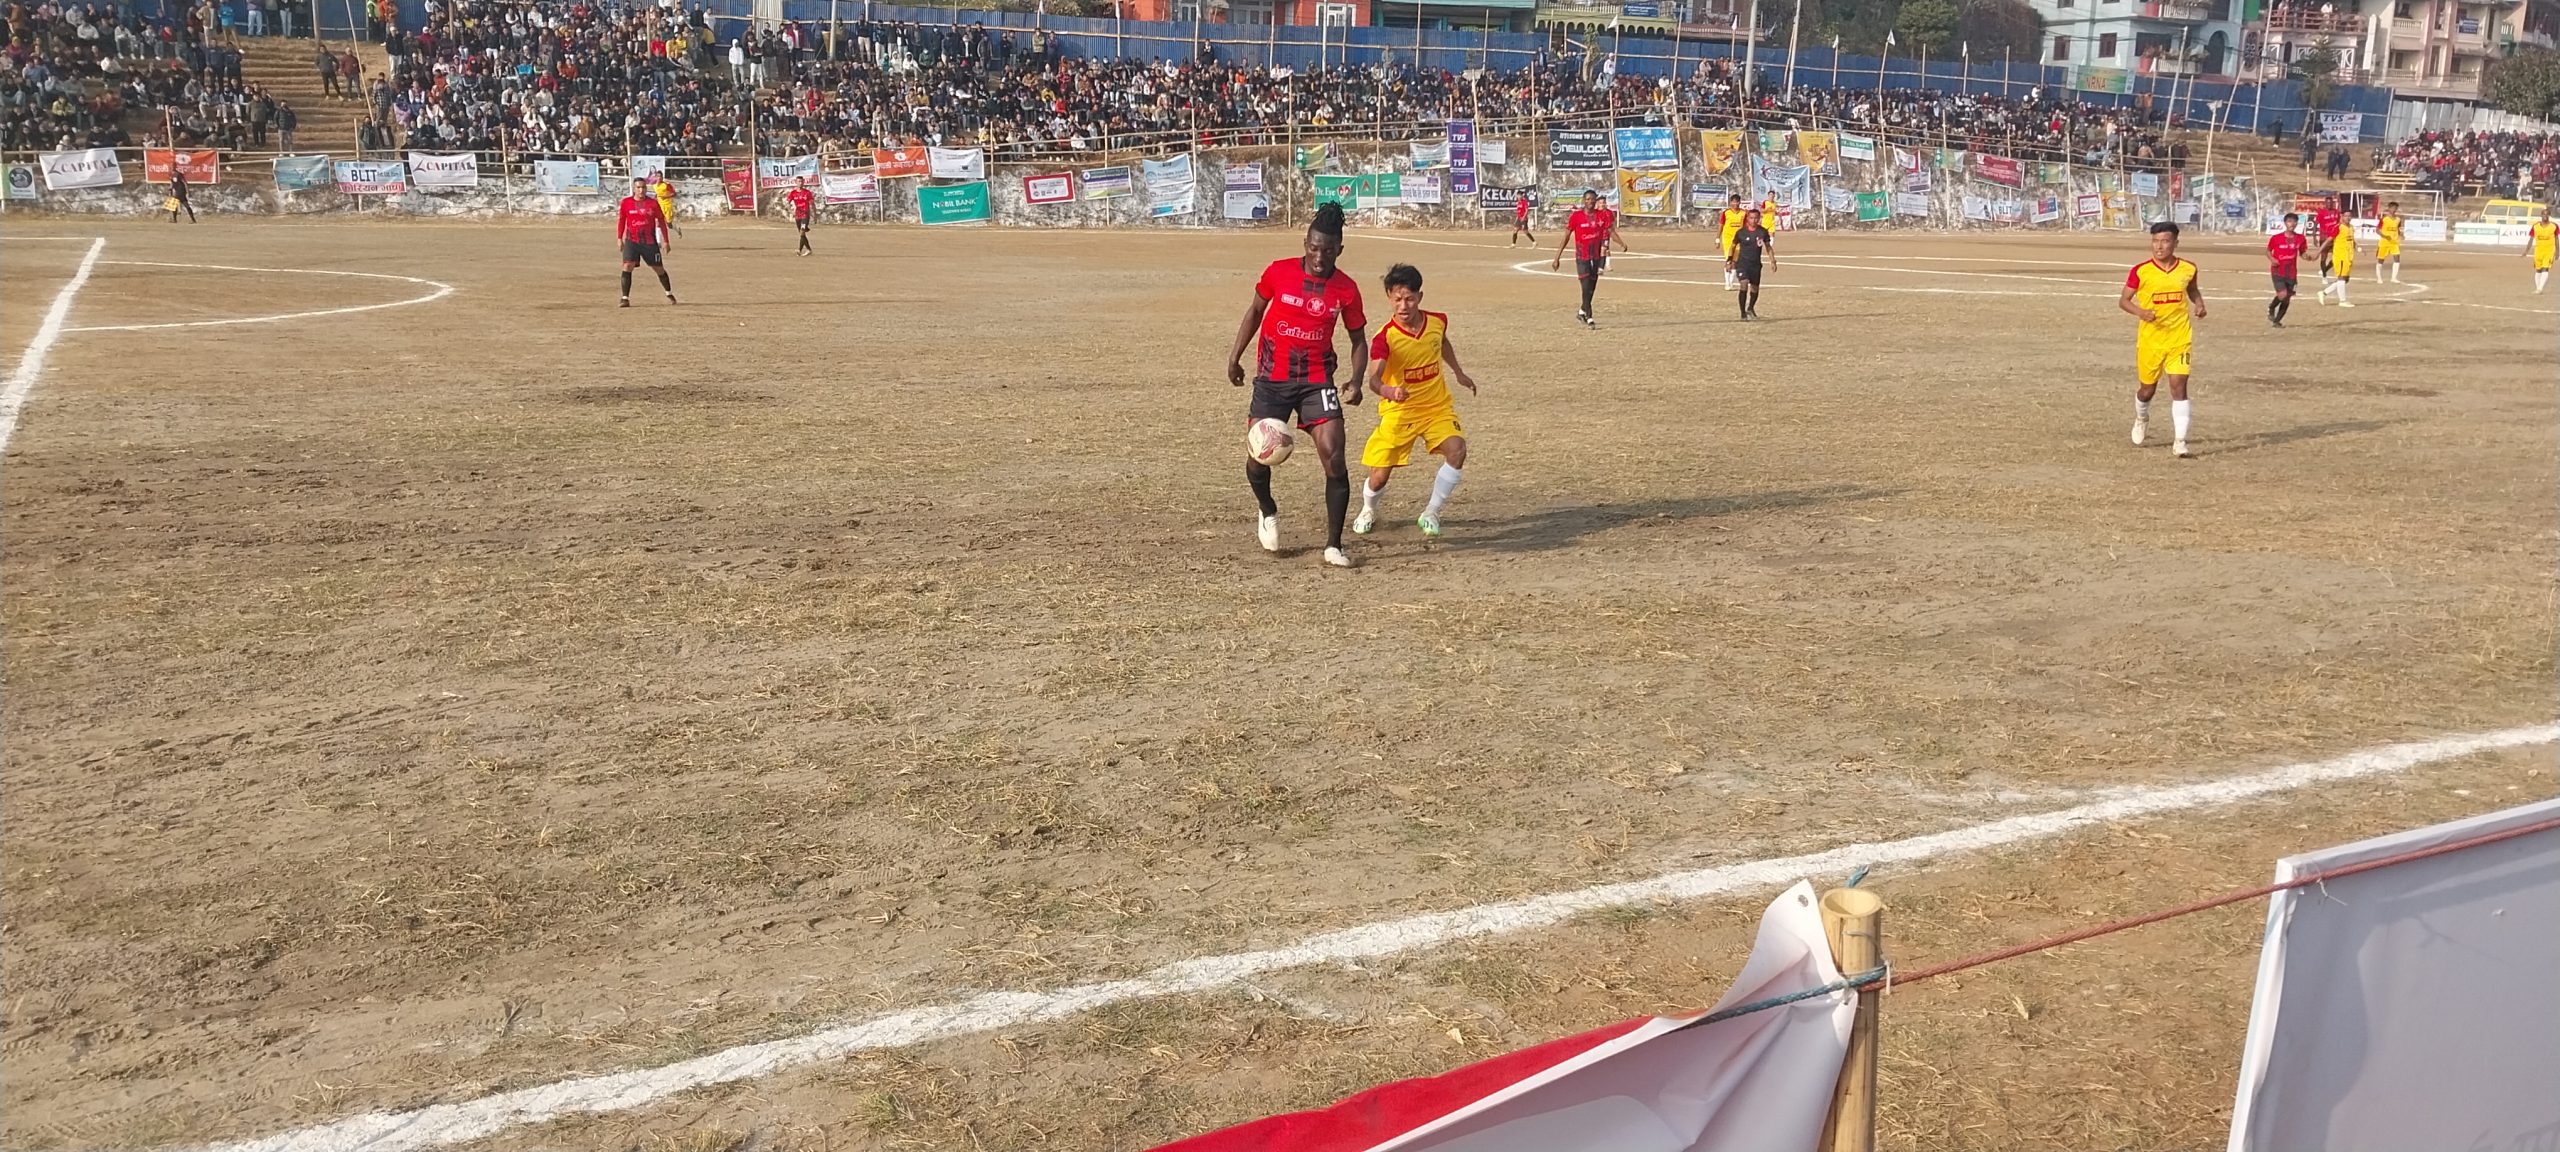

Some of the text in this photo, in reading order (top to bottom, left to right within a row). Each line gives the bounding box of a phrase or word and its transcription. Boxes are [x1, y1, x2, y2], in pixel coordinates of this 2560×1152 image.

[2323, 114, 2344, 122] TVS
[426, 162, 475, 170] CAPITAL
[773, 165, 796, 177] BLIT
[351, 170, 377, 182] BLIT
[1321, 388, 1339, 412] 13
